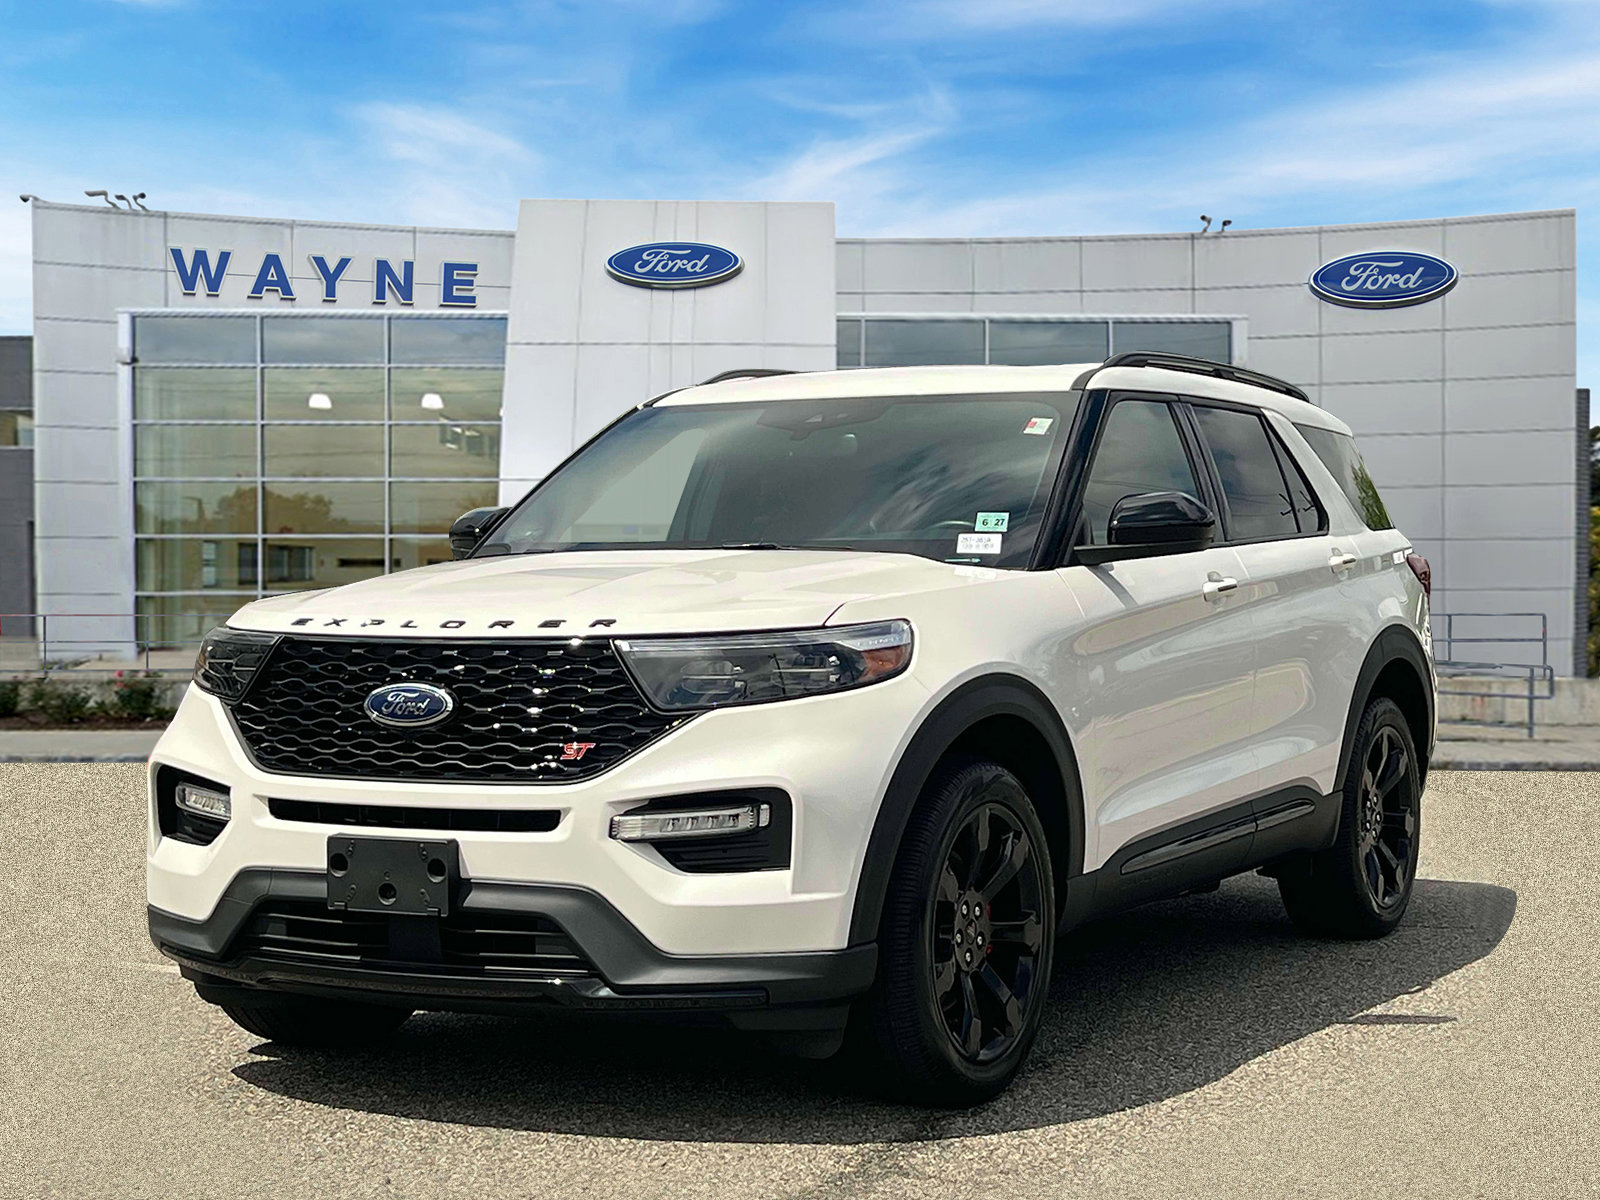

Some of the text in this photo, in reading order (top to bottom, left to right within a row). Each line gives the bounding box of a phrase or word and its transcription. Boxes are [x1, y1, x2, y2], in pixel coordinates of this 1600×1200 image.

[633, 248, 711, 274] Ford
[169, 246, 479, 307] WAYNE
[1340, 260, 1425, 292] Ford
[981, 518, 1006, 527] 6 27
[290, 617, 617, 629] EXPLORER
[381, 691, 431, 715] Ford
[560, 741, 597, 760] ST
